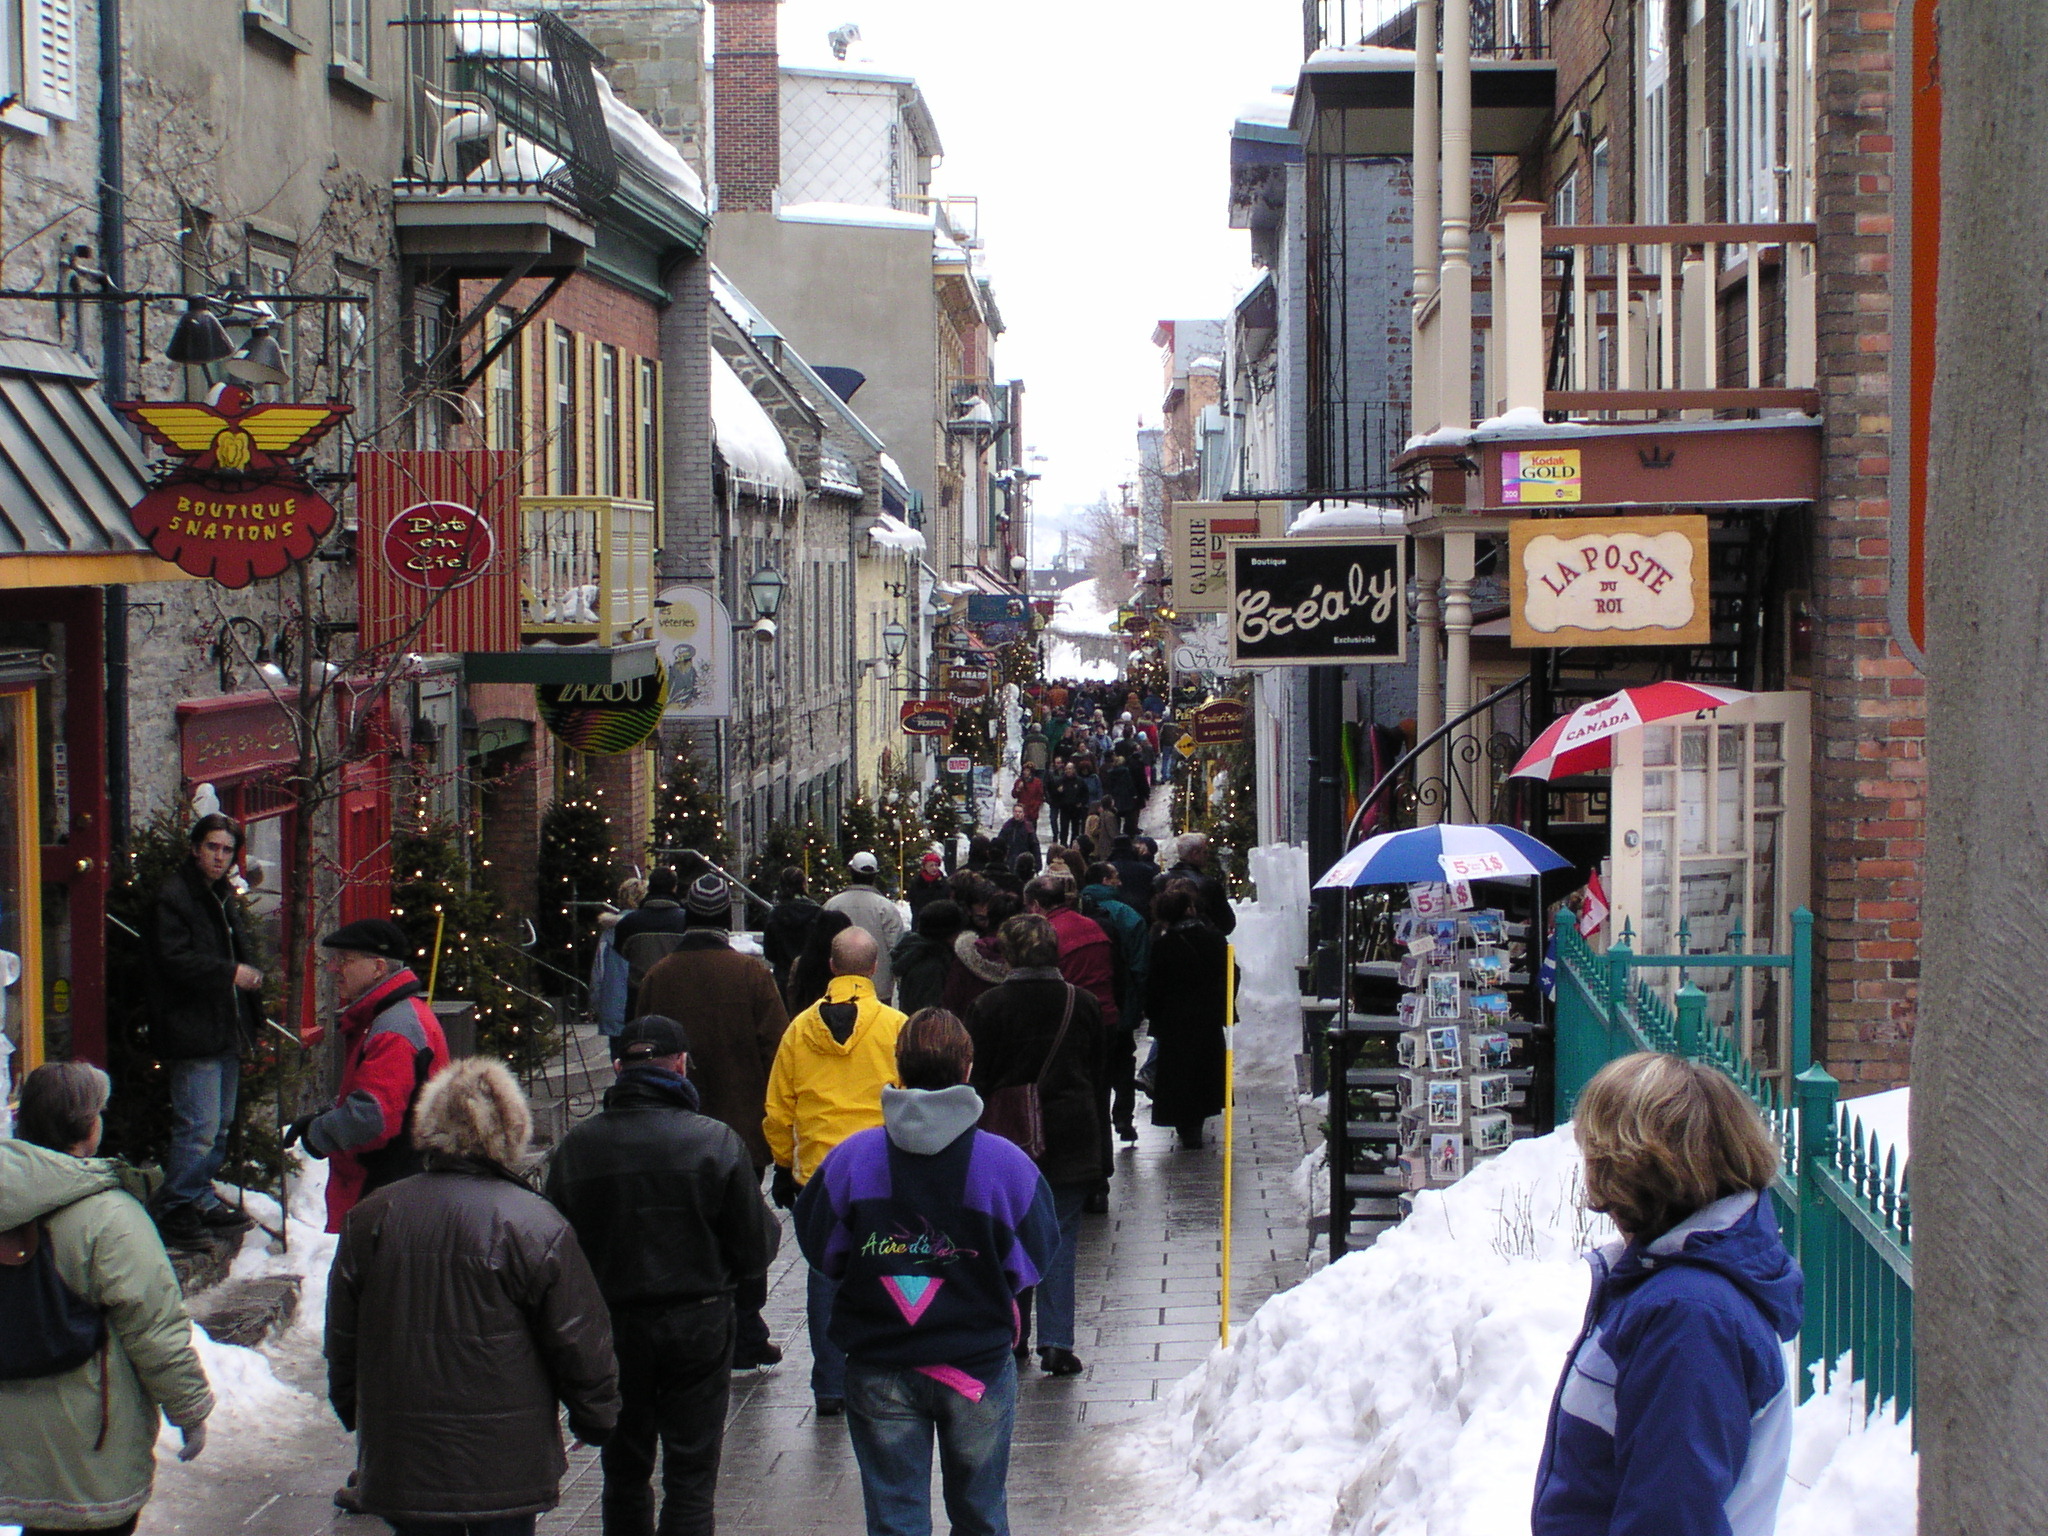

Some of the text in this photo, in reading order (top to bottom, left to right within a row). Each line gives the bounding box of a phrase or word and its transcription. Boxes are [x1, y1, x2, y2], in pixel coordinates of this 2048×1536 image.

[1531, 456, 1565, 466] Kodak
[1522, 466, 1575, 479] GOLD
[1504, 491, 1519, 499] 200
[177, 496, 296, 520] BOUTIQUE
[1189, 518, 1207, 595] GALERIE
[1251, 558, 1287, 567] Boutique
[1540, 544, 1674, 598] LA POSTE
[1599, 581, 1618, 592] DU
[1236, 562, 1397, 644] Créaly
[1594, 598, 1624, 613] ROI
[1333, 634, 1377, 645] Exclusivité
[1566, 711, 1631, 742] CANADA
[1453, 860, 1470, 875] 5
[1417, 893, 1433, 913] 5
